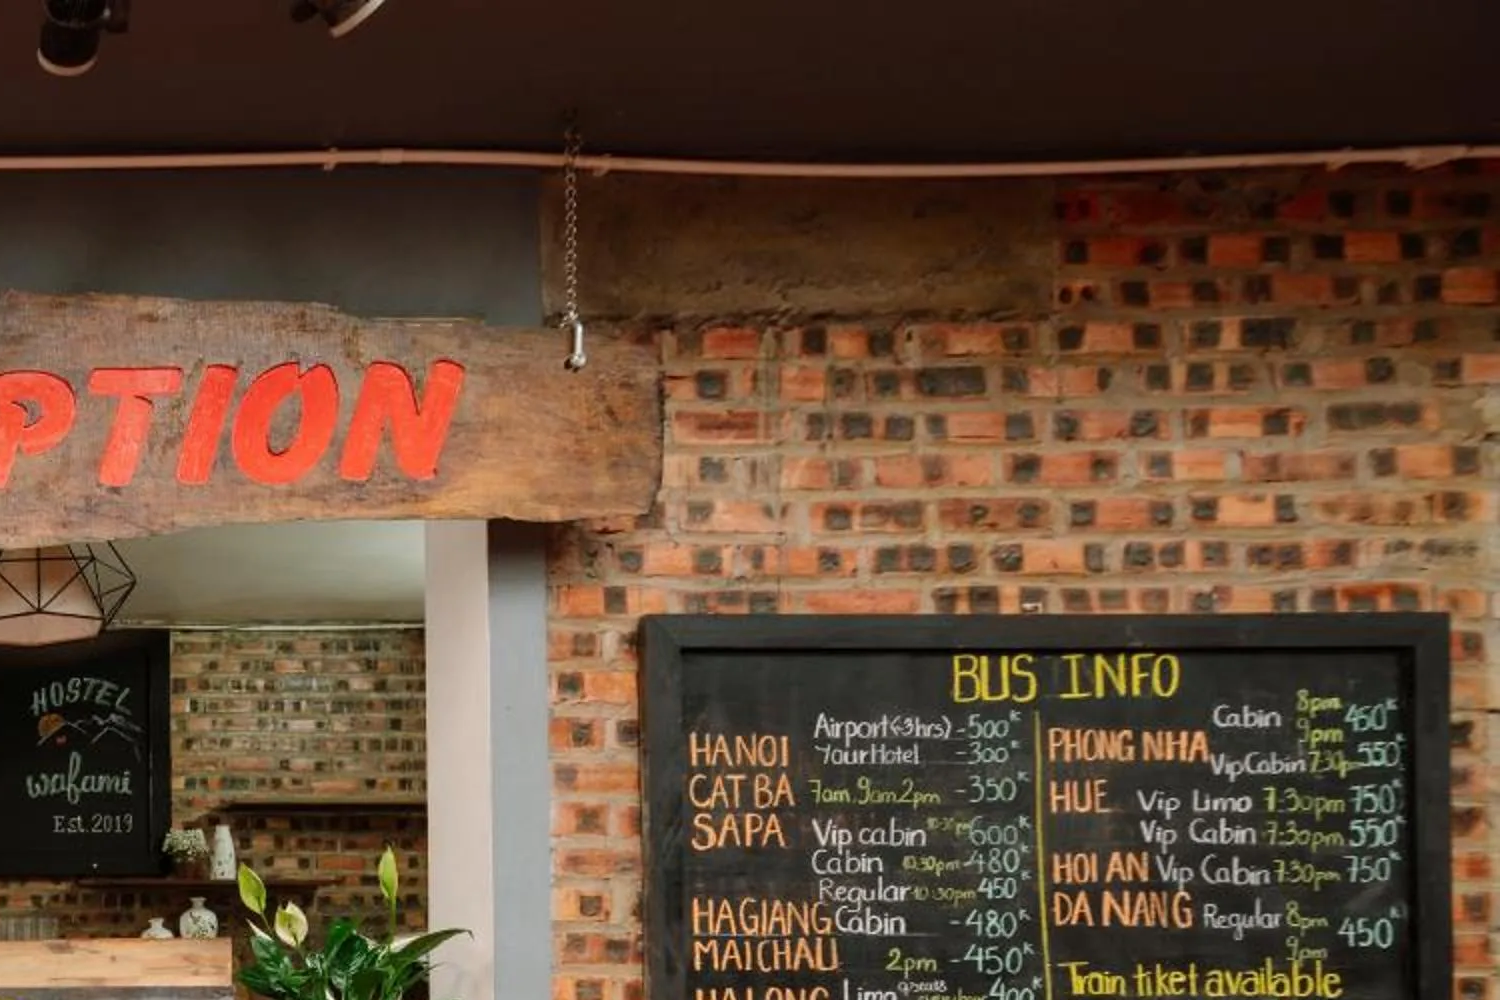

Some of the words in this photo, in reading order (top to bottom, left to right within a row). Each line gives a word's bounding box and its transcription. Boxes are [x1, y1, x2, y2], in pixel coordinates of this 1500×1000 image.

[32, 676, 133, 716] HOSTEL
[953, 654, 1036, 703] BUS
[1060, 653, 1181, 698] INFO
[689, 732, 790, 767] HANOI
[814, 712, 886, 747] Airport
[1048, 728, 1134, 762] PHONG
[1142, 730, 1209, 763] NHA
[1212, 704, 1282, 729] Cabin
[26, 752, 132, 802] wafami
[689, 774, 747, 809] CAT
[754, 775, 795, 808] BA
[1050, 779, 1110, 814] HUE
[1137, 790, 1181, 820] Vip
[1193, 789, 1252, 813] Limo
[692, 813, 787, 851] SAPA
[812, 818, 852, 854] Vip
[1140, 820, 1177, 854] Vip
[1189, 818, 1256, 845] Cabin
[812, 849, 883, 875] Cabin
[1052, 853, 1097, 884] HOI
[1105, 851, 1149, 883] AN
[1156, 855, 1195, 891] Vip
[1201, 854, 1270, 885] Cabin
[819, 877, 911, 912] Regular
[835, 905, 906, 936] Cabin
[1052, 893, 1094, 927] DA
[1103, 892, 1193, 928] NANG
[1203, 898, 1283, 941] Regular
[885, 948, 937, 979] 2pm
[1058, 961, 1125, 996] Train
[1135, 962, 1199, 997] tiket
[1205, 957, 1343, 998] available
